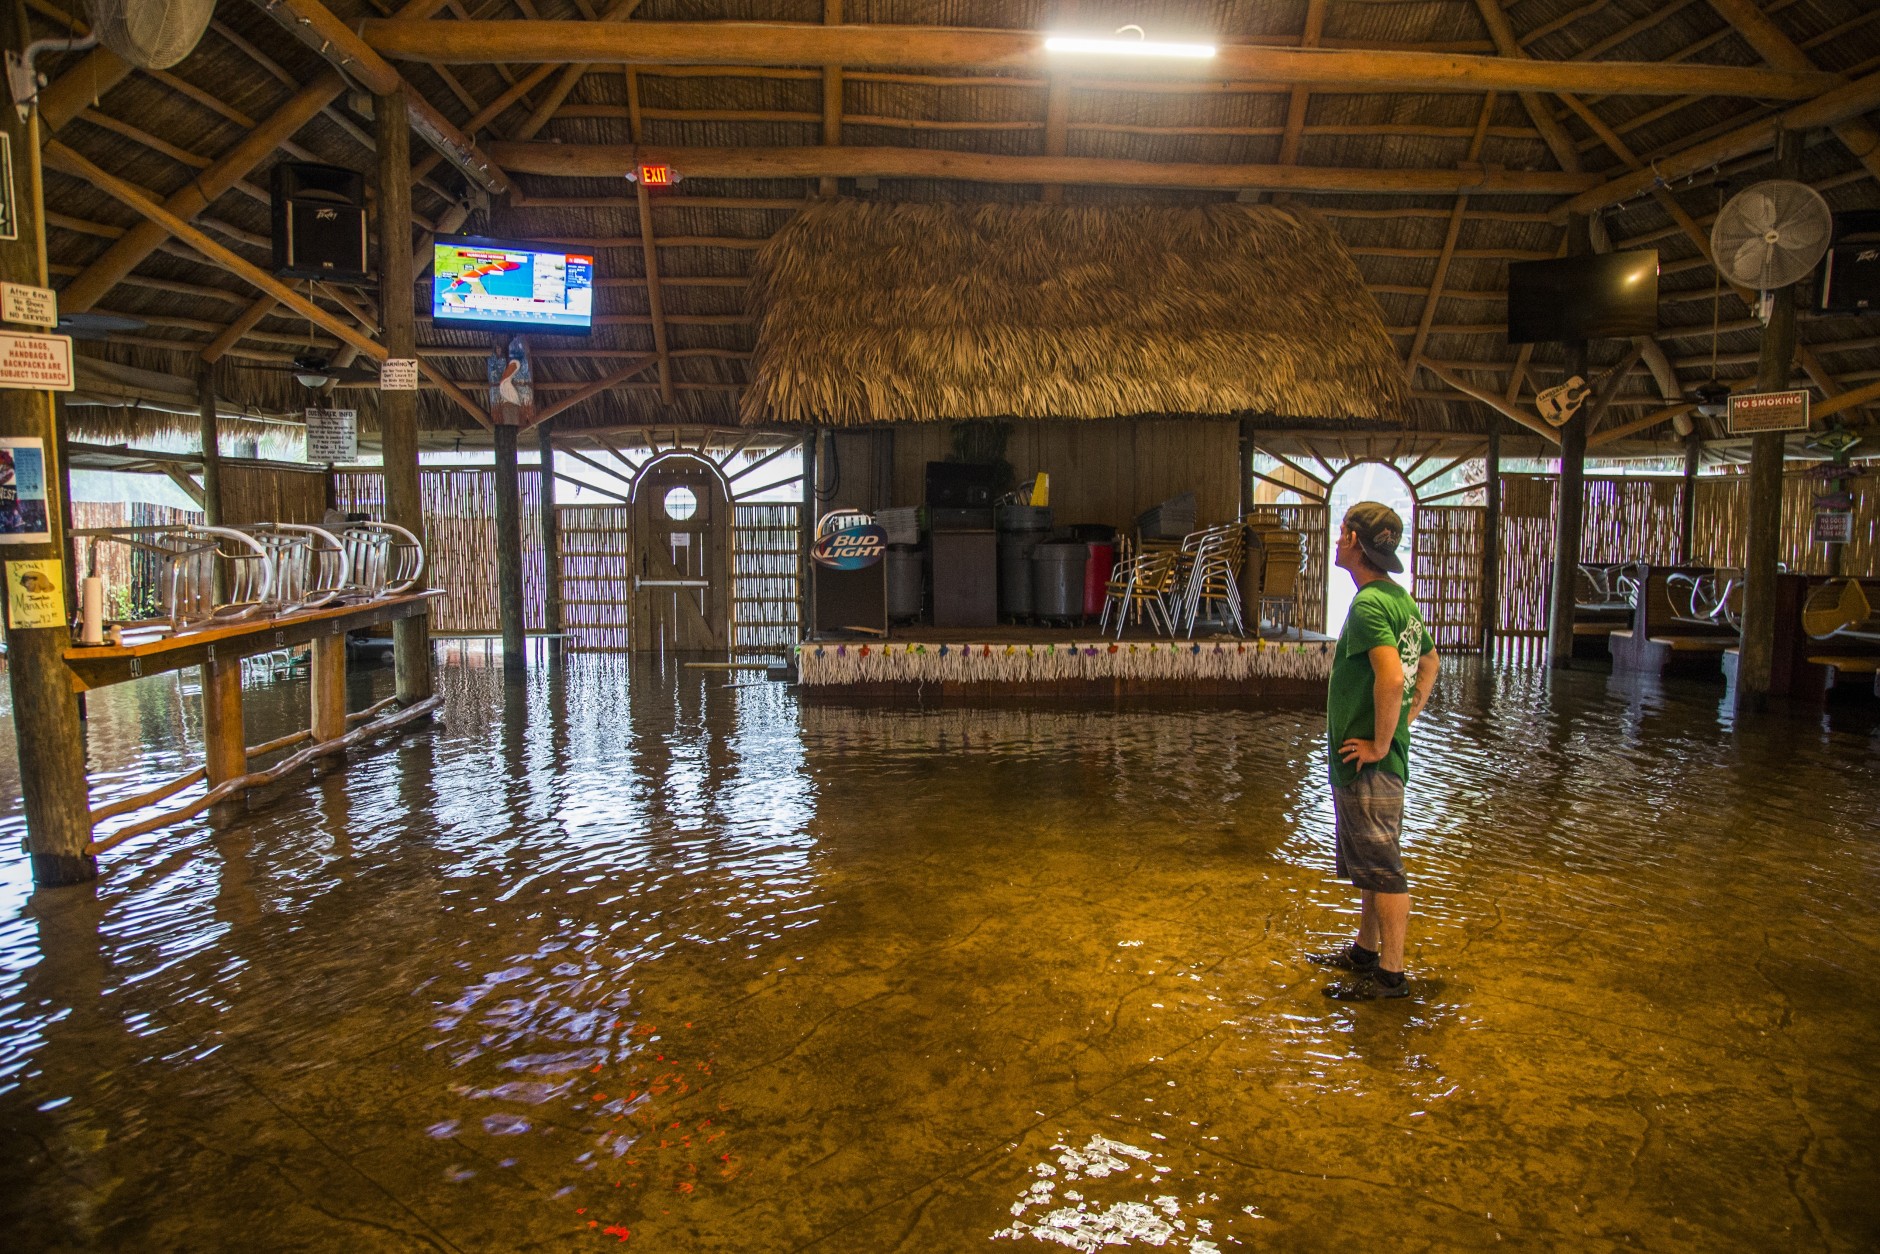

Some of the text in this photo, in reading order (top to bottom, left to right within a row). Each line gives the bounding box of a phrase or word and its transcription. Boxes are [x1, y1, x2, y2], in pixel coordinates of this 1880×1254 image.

[642, 167, 667, 182] EXIT
[10, 287, 29, 297] After
[14, 340, 50, 352] ALL BAGS,
[9, 350, 55, 361] HANDBAGS &
[3, 360, 62, 371] BACKPACKS ARE
[0, 369, 66, 381] SUBJECT TO SEARCH
[1734, 396, 1802, 409] NO SMOKING
[833, 535, 879, 547] BUD
[822, 545, 886, 558] LIGHT
[130, 657, 142, 678] 40
